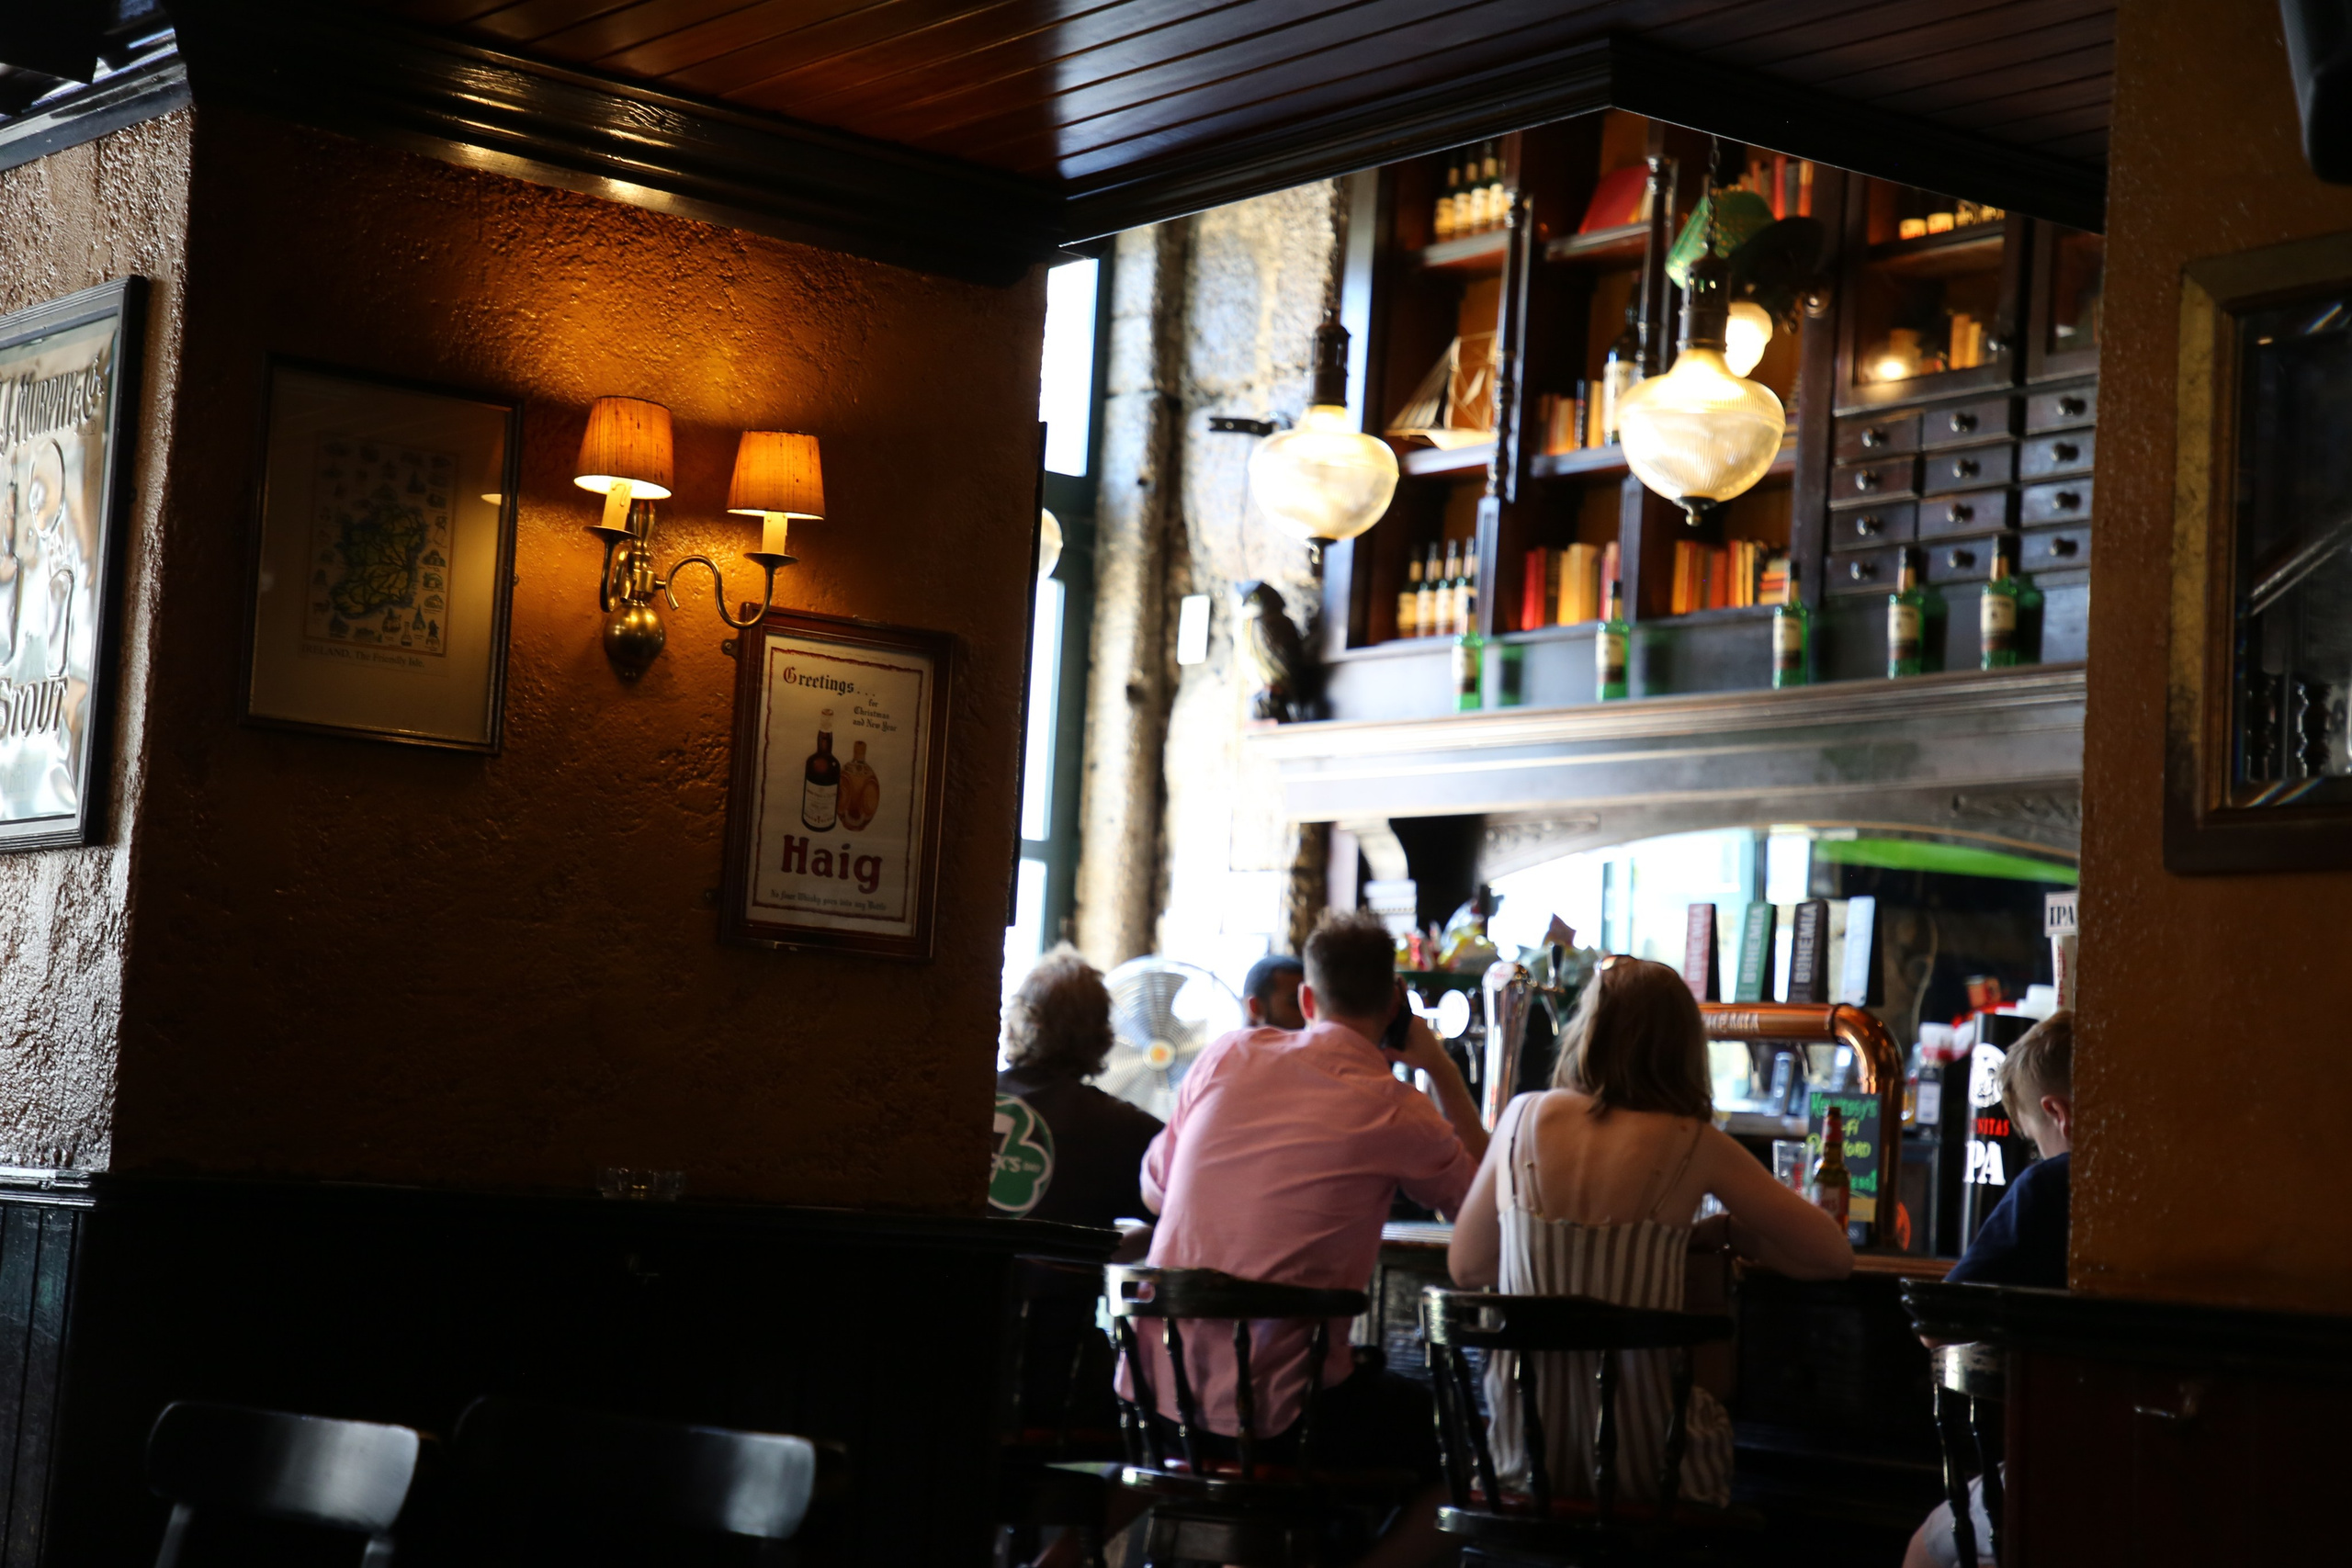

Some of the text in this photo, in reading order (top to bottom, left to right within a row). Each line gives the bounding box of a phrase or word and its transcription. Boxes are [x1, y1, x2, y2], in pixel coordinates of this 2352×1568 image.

[355, 650, 371, 661] The
[373, 652, 407, 668] Friendly
[868, 698, 879, 708] for
[854, 706, 891, 721] Christmas
[853, 716, 899, 733] and New Year
[781, 834, 883, 895] Haig
[2049, 905, 2075, 927] IPA
[1742, 906, 1767, 983] BOHEMIA
[1793, 903, 1818, 983] BOHEMIA
